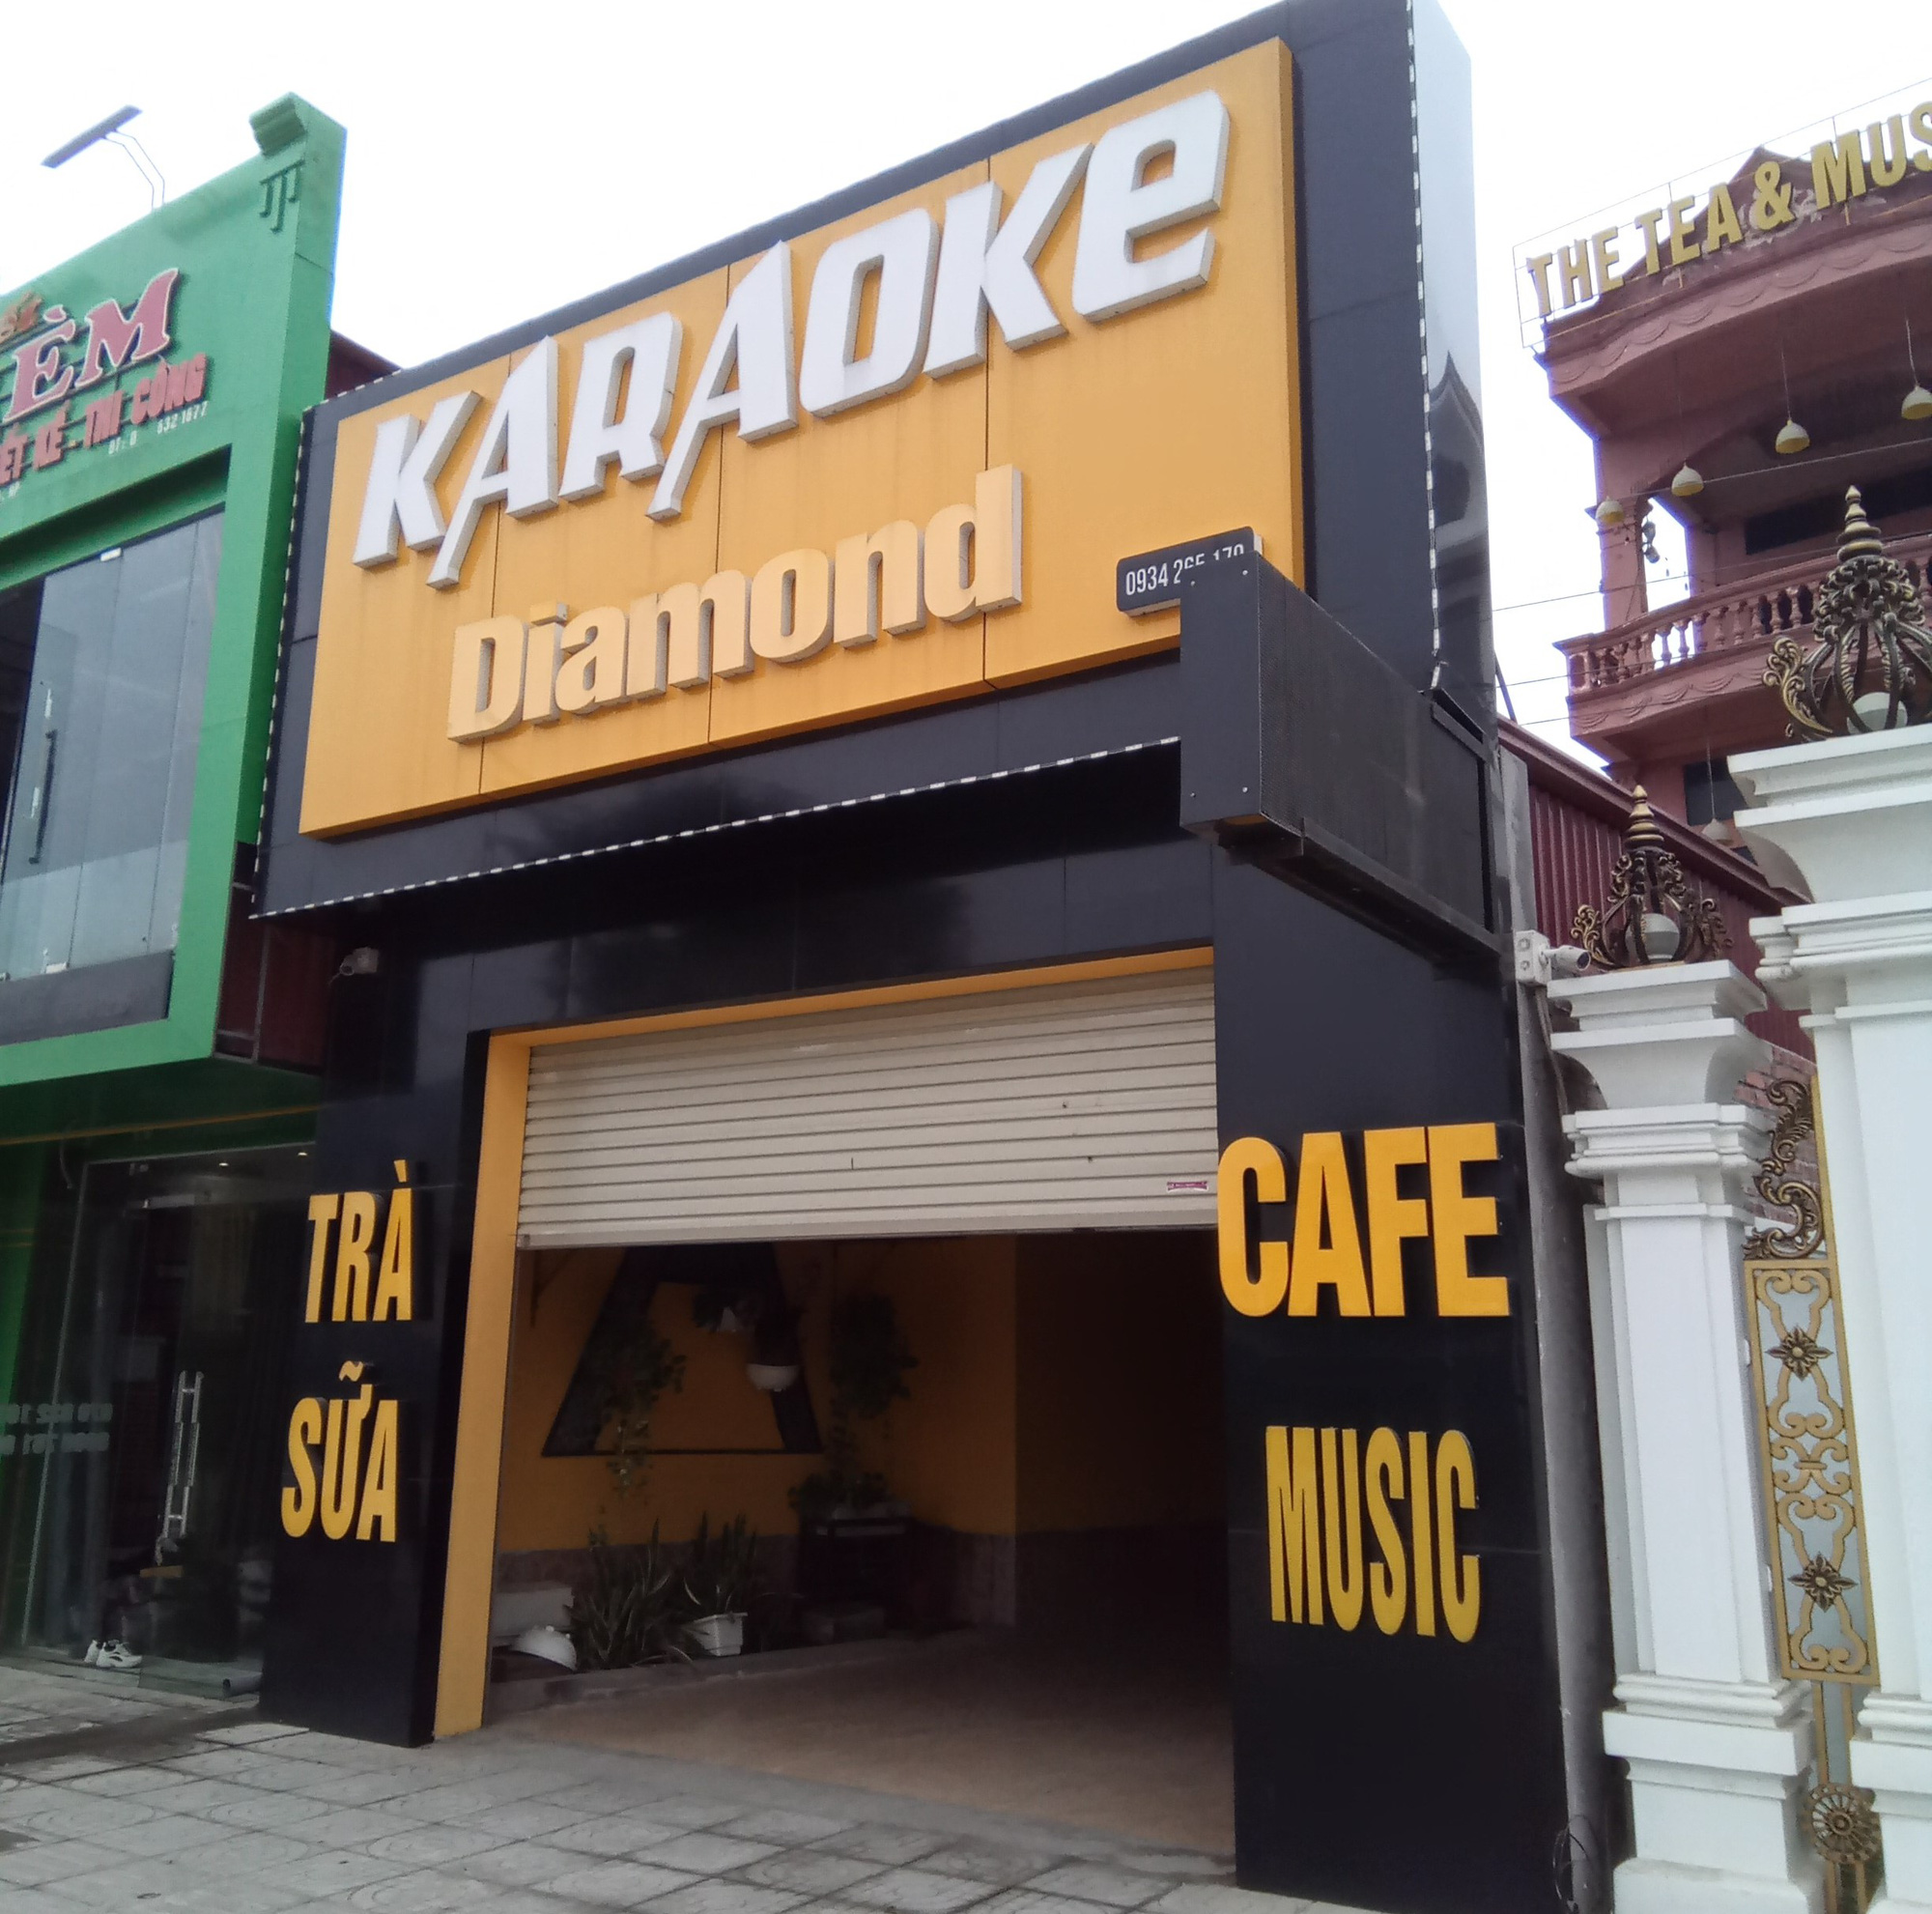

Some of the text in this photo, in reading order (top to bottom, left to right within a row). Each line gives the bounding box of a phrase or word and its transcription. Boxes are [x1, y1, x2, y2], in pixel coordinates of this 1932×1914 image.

[1526, 225, 1625, 318] THE
[1634, 182, 1744, 275] TEA
[1752, 160, 1796, 231] &
[352, 89, 1232, 591] KARAOKE
[447, 464, 1025, 745] Diamond
[1125, 562, 1169, 595] 0934
[305, 1159, 413, 1324] TRÀ
[1217, 1123, 1510, 1317] CAFE
[281, 1360, 399, 1543] SỮA
[1265, 1426, 1480, 1643] MUSIC
